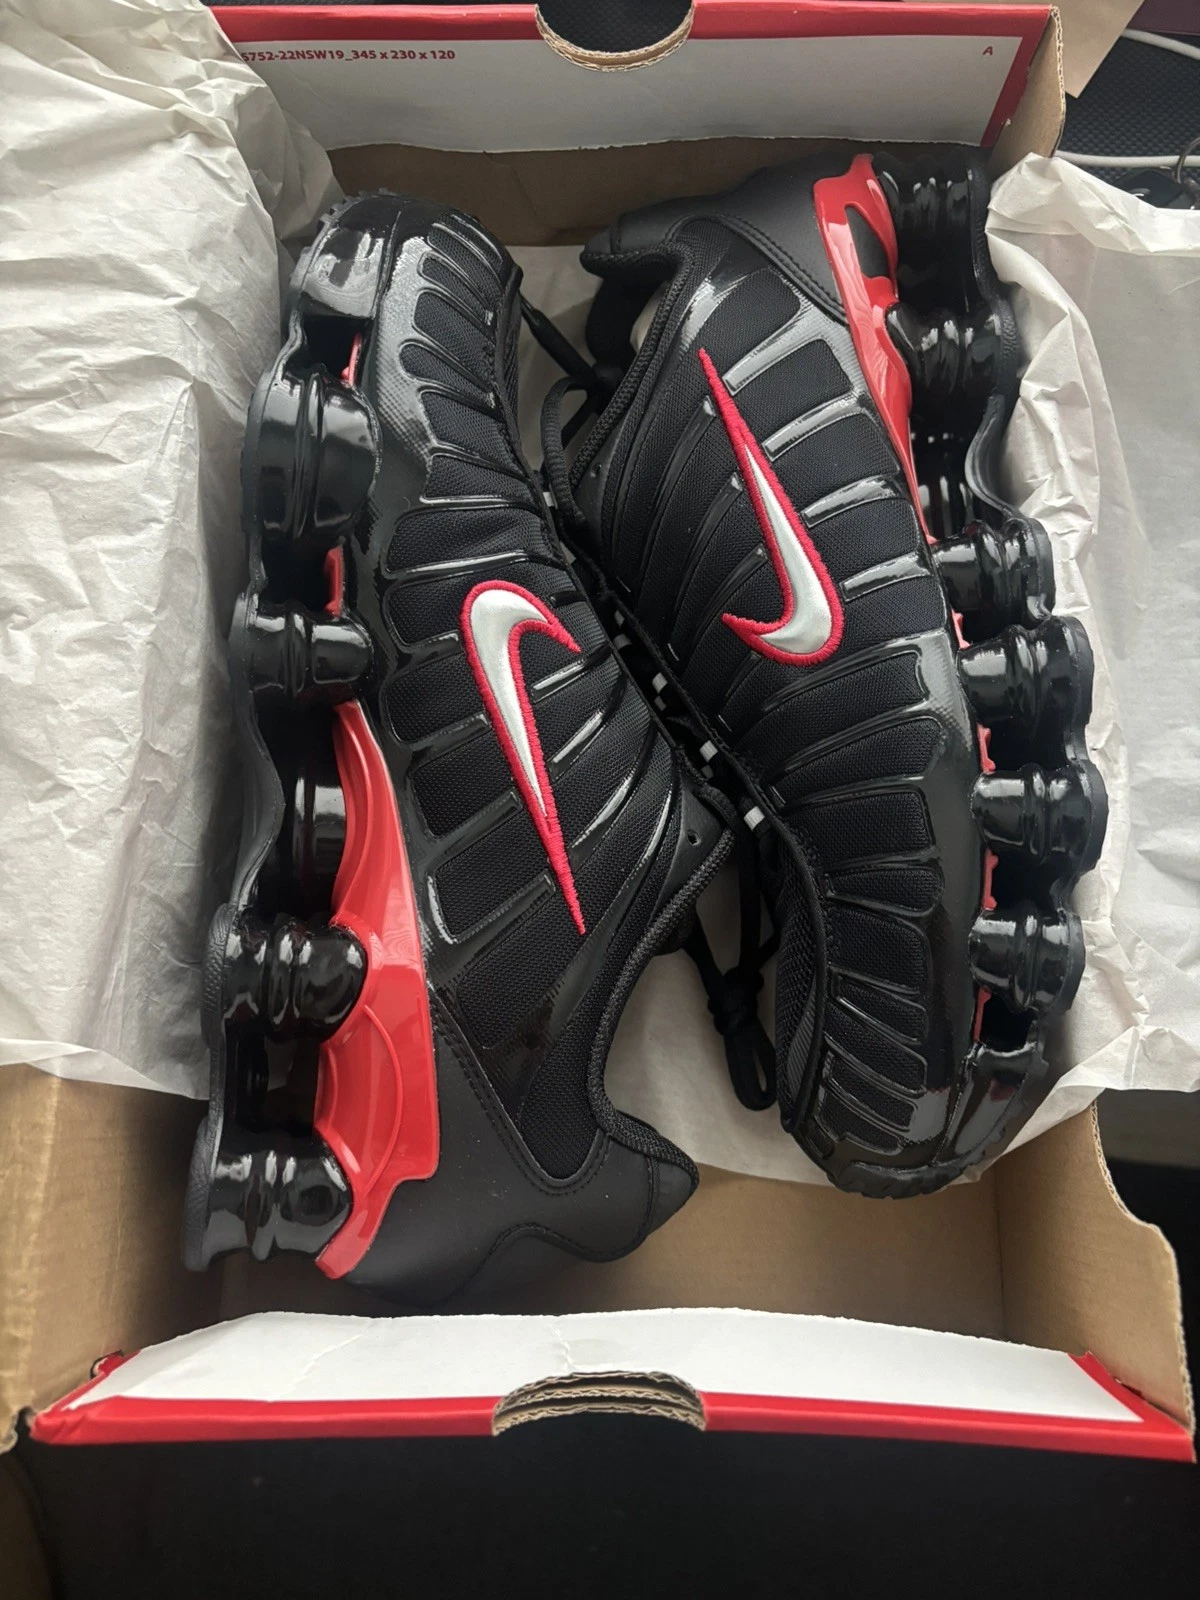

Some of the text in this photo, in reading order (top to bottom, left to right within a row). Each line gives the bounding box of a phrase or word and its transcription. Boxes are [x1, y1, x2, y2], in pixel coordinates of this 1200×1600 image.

[393, 50, 416, 60] 230
[431, 50, 456, 60] 120
[982, 46, 993, 56] A
